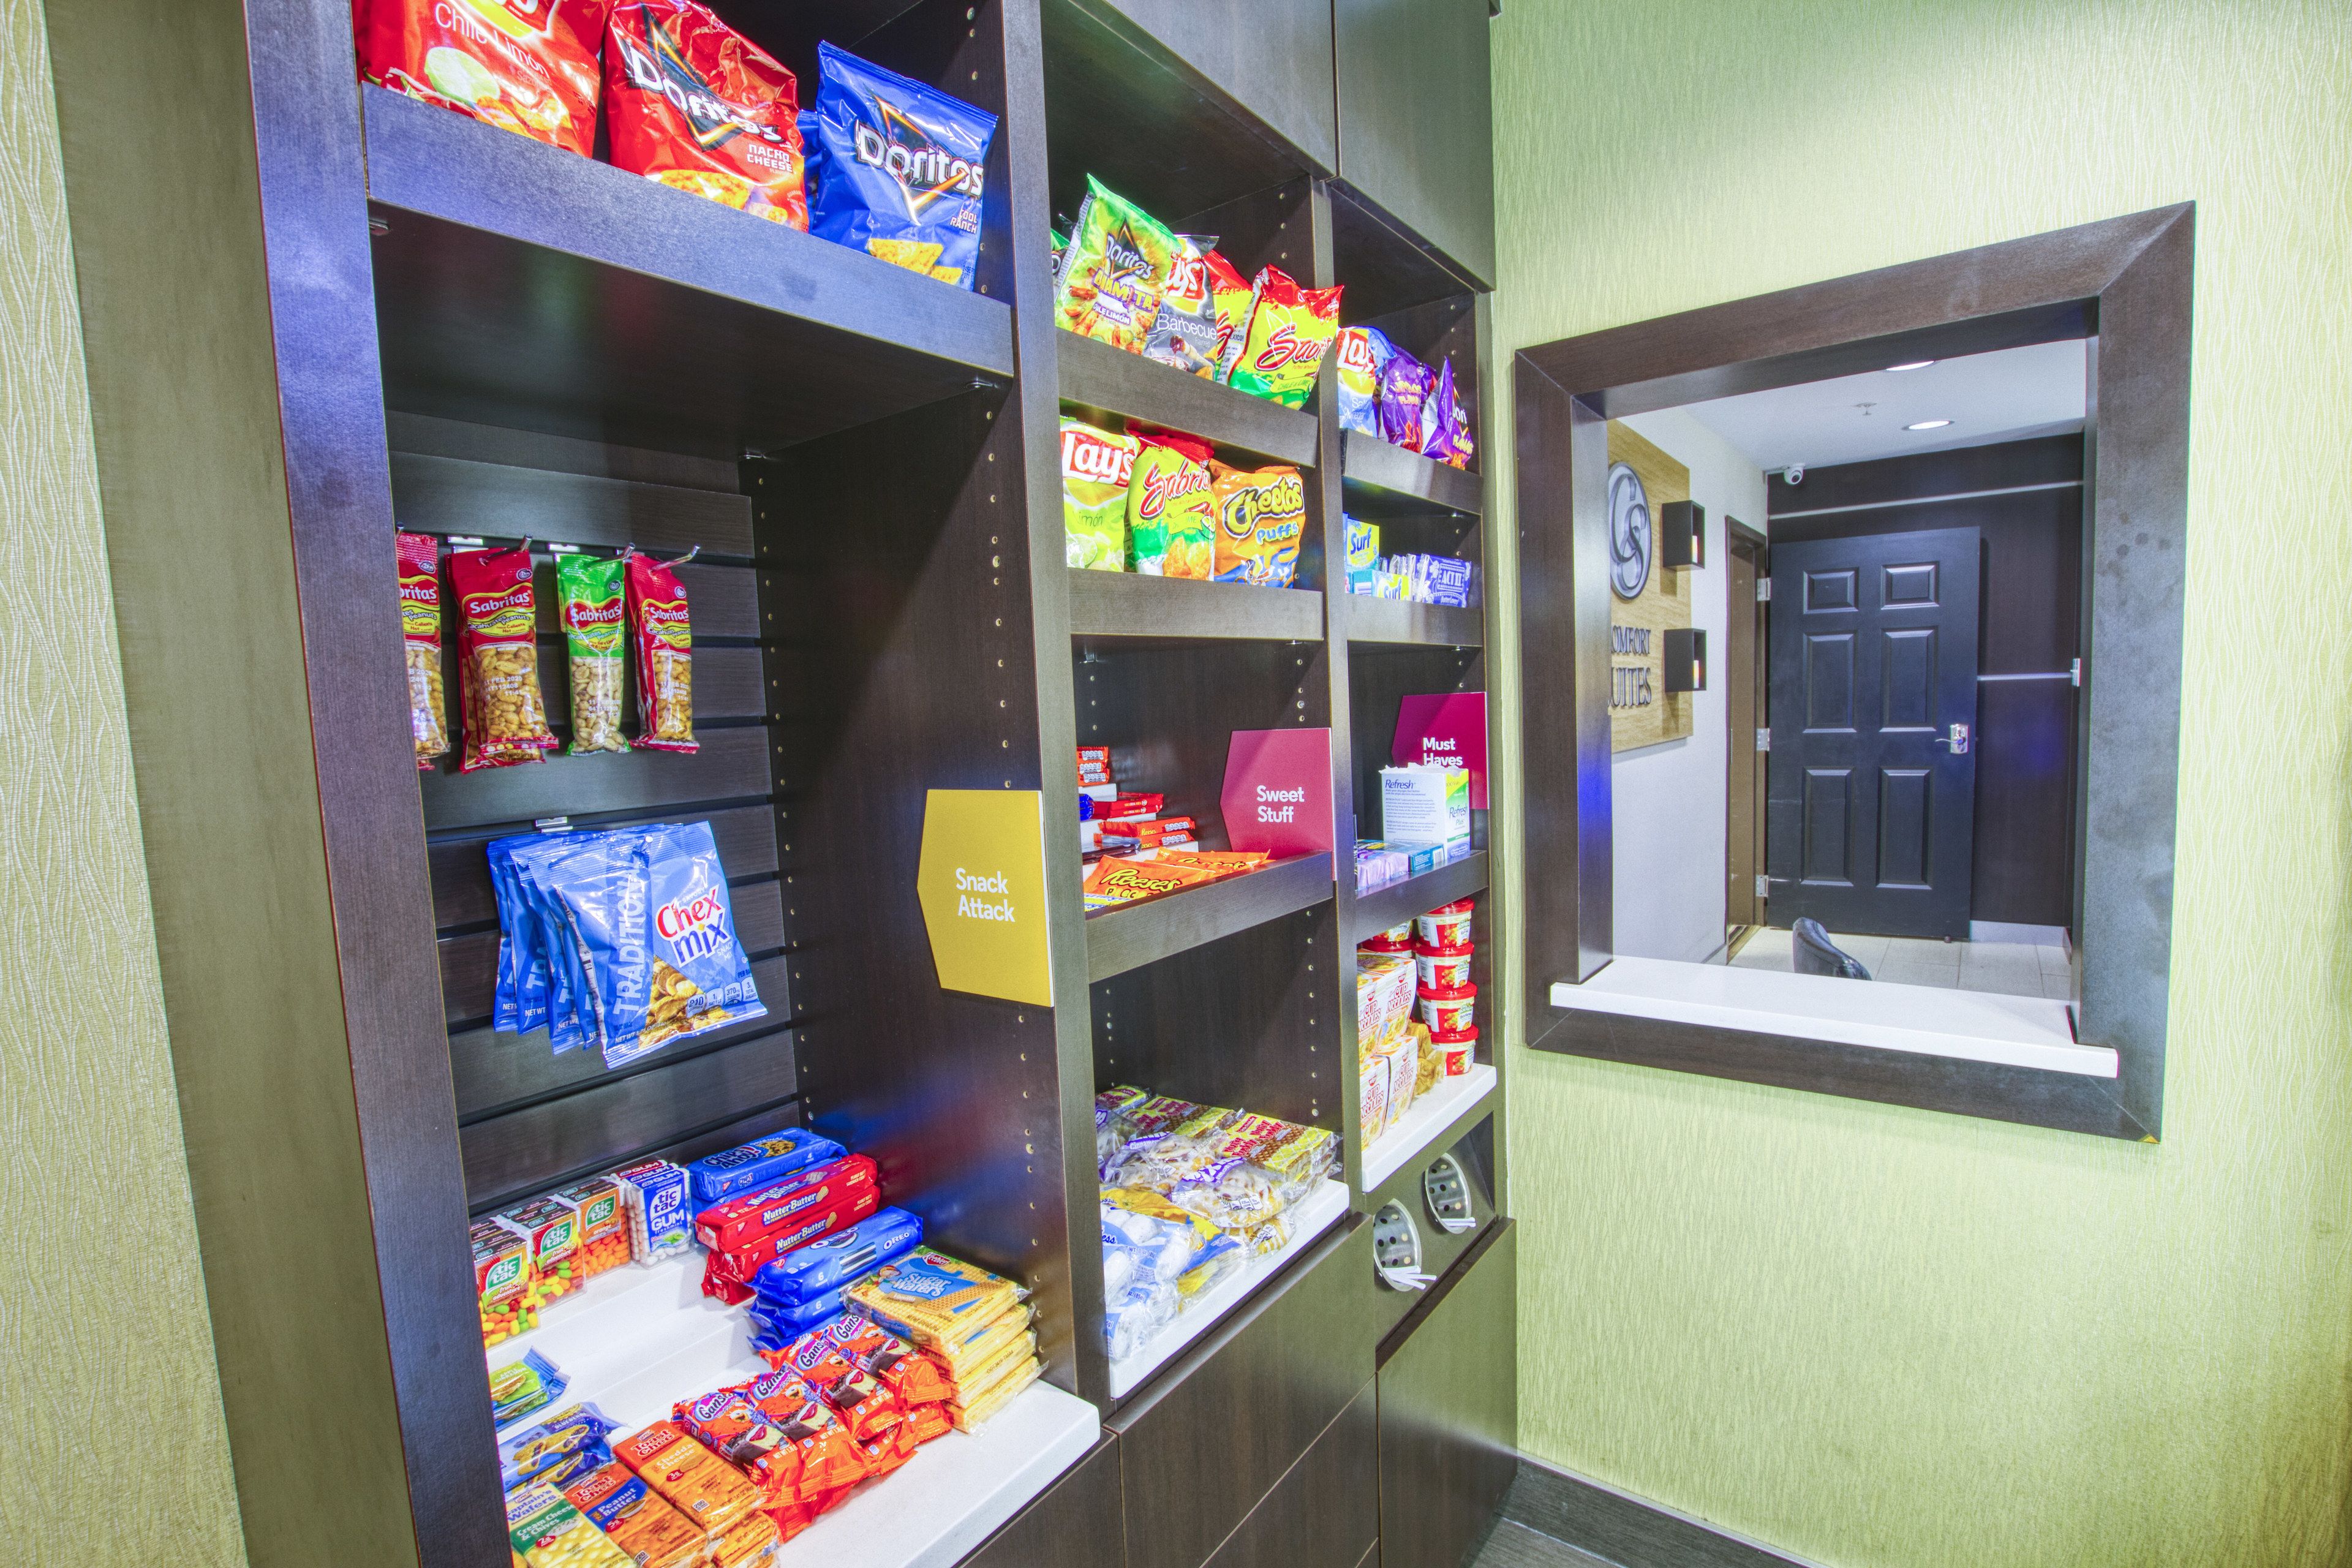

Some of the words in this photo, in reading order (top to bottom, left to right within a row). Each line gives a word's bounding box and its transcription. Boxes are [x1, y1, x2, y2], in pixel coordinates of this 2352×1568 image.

[435, 2, 488, 44] Chile
[493, 30, 550, 79] Limón
[628, 42, 783, 143] Doritos
[746, 153, 793, 173] CHEESE
[748, 144, 790, 164] NACHO
[858, 123, 984, 197] Doritos
[950, 216, 978, 234] RANCH
[960, 208, 978, 224] COOL
[1106, 234, 1155, 280] Doritos
[1156, 313, 1217, 341] Barbecue
[1061, 431, 1136, 484] Lay's
[1226, 479, 1303, 534] Cheetos
[1350, 526, 1372, 555] Surf
[1383, 578, 1402, 600] Surf
[470, 590, 530, 614] Sabritas
[571, 605, 622, 622] Sabritas
[650, 606, 690, 622] Sabritas
[1611, 625, 1651, 655] OMFORT
[1609, 666, 1652, 706] UITES
[1423, 737, 1456, 751] Must
[1423, 753, 1463, 766] Haves
[1256, 785, 1305, 802] Sweet
[1385, 779, 1414, 790] Refresh
[1257, 805, 1294, 823] Stuff
[956, 867, 1009, 894] Snack
[657, 889, 722, 938] Chex
[957, 894, 1016, 922] Attack
[673, 912, 729, 964] mix
[1395, 982, 1409, 997] CUP
[689, 996, 704, 1008] 210
[524, 1009, 535, 1017] NET
[557, 1020, 570, 1030] NET
[1129, 1138, 1162, 1150] Cinnamo
[631, 1161, 660, 1172] GUM
[704, 1147, 743, 1167] Chips
[721, 1146, 761, 1169] Ahoy!
[642, 1165, 670, 1177] GUM
[653, 1170, 681, 1182] GUM
[658, 1189, 677, 1204] tic
[747, 1186, 780, 1205] Nutter
[769, 1181, 800, 1199] Butter
[590, 1208, 611, 1221] tac
[595, 1200, 613, 1213] tic
[653, 1199, 677, 1214] tac
[763, 1205, 790, 1221] Nutter
[790, 1192, 817, 1211] Butter
[593, 1224, 612, 1235] orange
[651, 1209, 685, 1231] GUM
[655, 1221, 683, 1235] freshmint
[545, 1233, 568, 1248] tac
[549, 1225, 569, 1238] tic
[775, 1232, 801, 1250] Nutter
[801, 1218, 826, 1237] Butter
[883, 1232, 910, 1251] OREO
[496, 1260, 519, 1275] tic
[923, 1252, 950, 1266] Keebler
[492, 1268, 516, 1284] tac
[818, 1272, 824, 1281] 6
[908, 1273, 952, 1287] Sugar
[492, 1286, 521, 1300] adventure
[499, 1283, 513, 1294] fruit
[891, 1276, 946, 1297] Wafers
[815, 1300, 822, 1310] 6
[836, 1314, 860, 1339] Gans
[800, 1340, 825, 1367] Gans
[630, 1428, 671, 1451] Toast
[637, 1433, 675, 1457] Chee
[656, 1441, 697, 1467] Cheddar
[661, 1449, 696, 1471] Cheese
[571, 1474, 612, 1498] Toast
[579, 1479, 617, 1502] Chee
[507, 1494, 557, 1521] Wafers
[598, 1487, 637, 1513] Peanut
[603, 1493, 637, 1517] Butter
[516, 1517, 546, 1536] Cream
[521, 1532, 531, 1542] &
[530, 1518, 560, 1537] Chives
